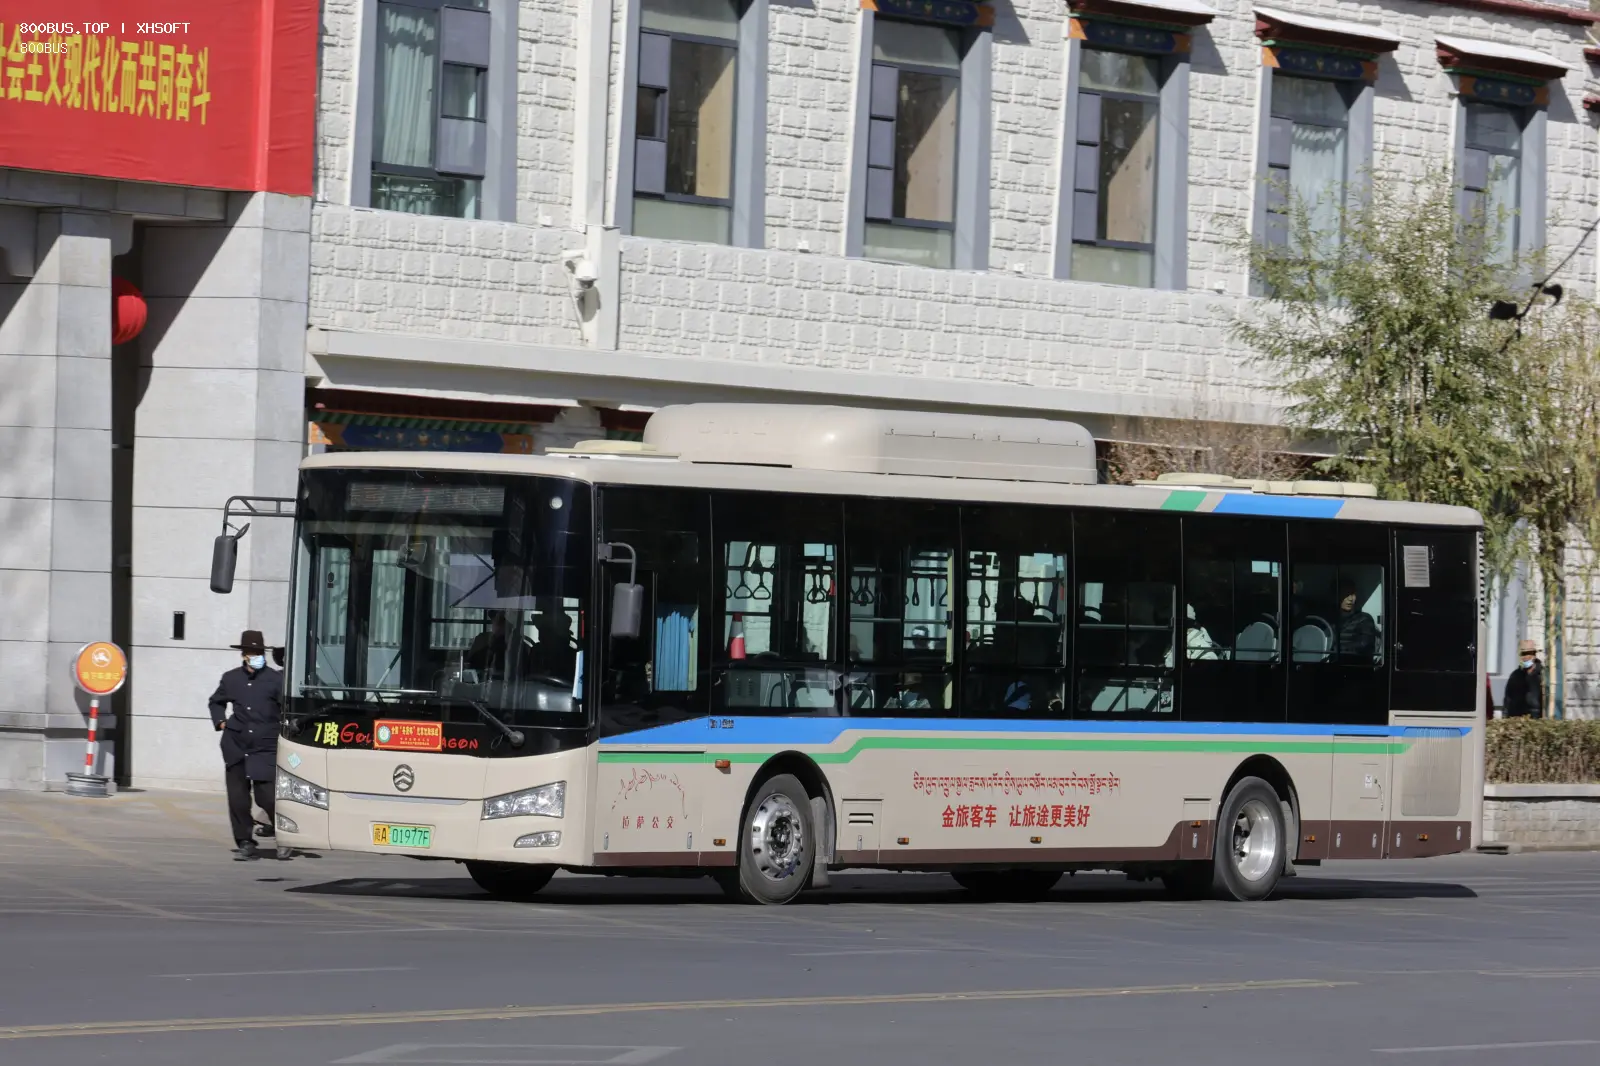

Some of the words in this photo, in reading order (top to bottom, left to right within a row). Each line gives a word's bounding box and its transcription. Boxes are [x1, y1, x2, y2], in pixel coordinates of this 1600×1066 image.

[314, 721, 339, 746] 7路
[942, 804, 997, 828] 金旅客车
[1009, 804, 1090, 827] 让旅途更美好
